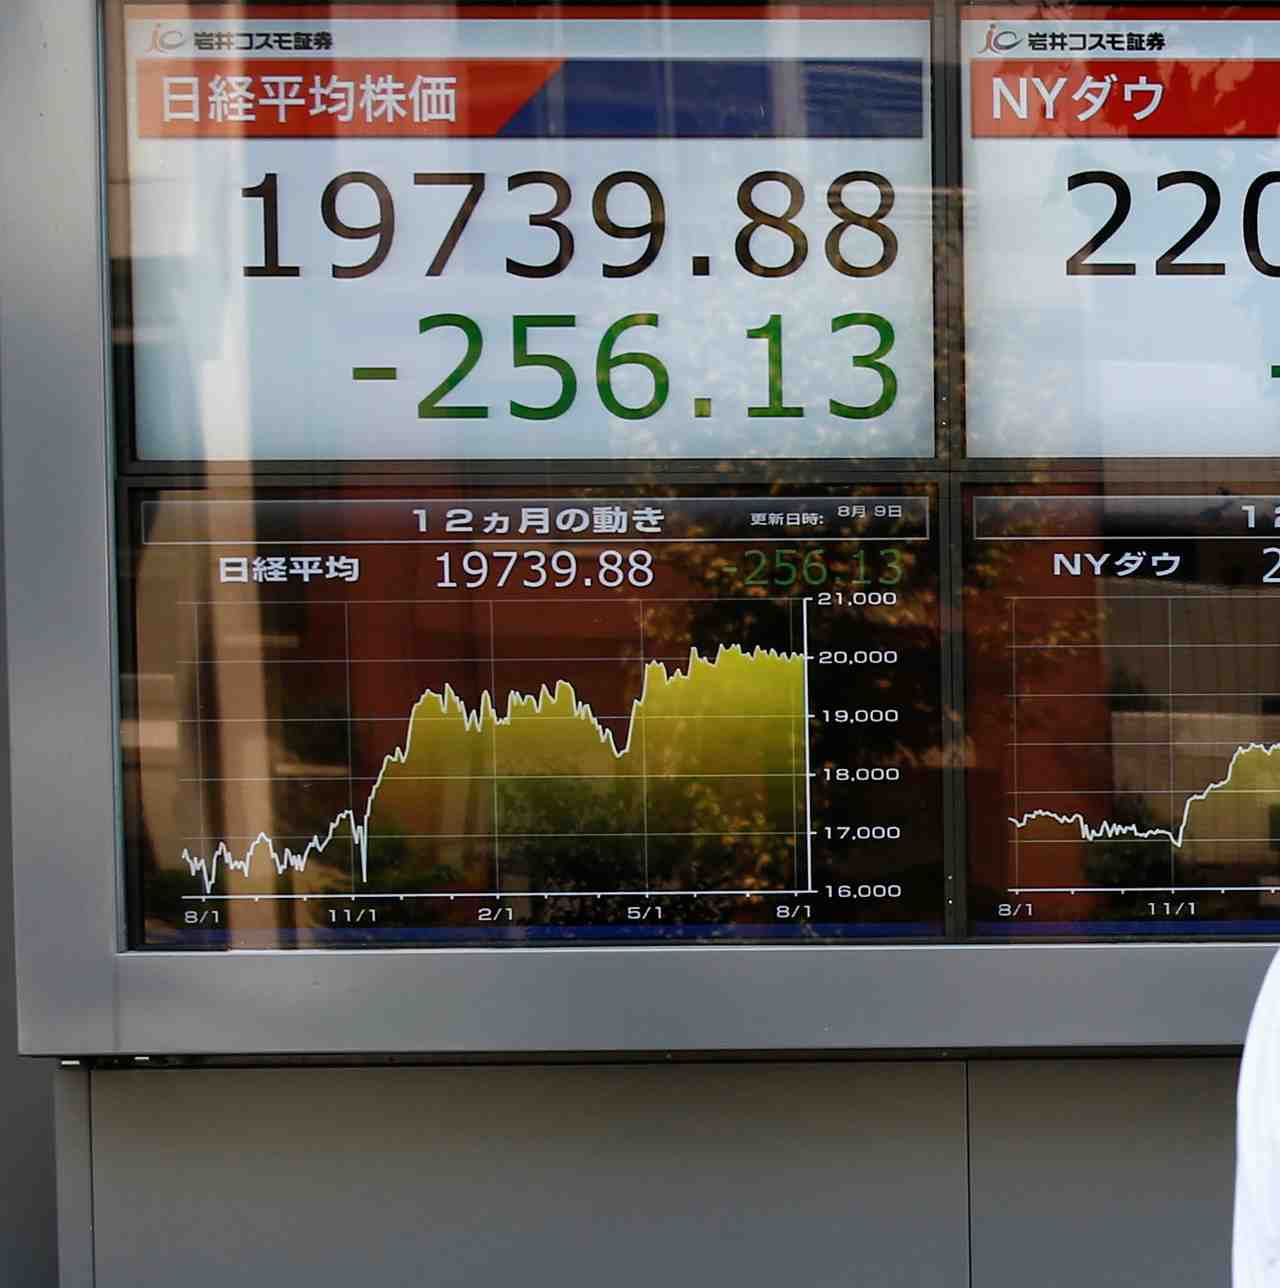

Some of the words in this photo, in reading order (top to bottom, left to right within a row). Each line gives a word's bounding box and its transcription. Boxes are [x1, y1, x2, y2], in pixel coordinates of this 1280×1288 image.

[193, 31, 334, 51] 岩井コスモ証券
[1028, 32, 1166, 51] 岩井コスモ証券
[162, 73, 458, 124] 日経平均株価
[992, 73, 1164, 121] NYダウ
[241, 170, 899, 278] 19739.88
[352, 312, 898, 419] -256.13
[219, 556, 361, 583] 日経平均
[436, 550, 653, 587] 19739.88
[723, 549, 902, 585] -256.13
[1053, 551, 1181, 577] NYダウ
[184, 910, 219, 924] 8/1
[328, 908, 376, 923] 11/1
[478, 907, 513, 921] 2/1
[627, 906, 662, 920] 5/1
[776, 905, 811, 919] 8/1
[998, 903, 1032, 917] 8/1
[1147, 902, 1195, 916] 11/1
